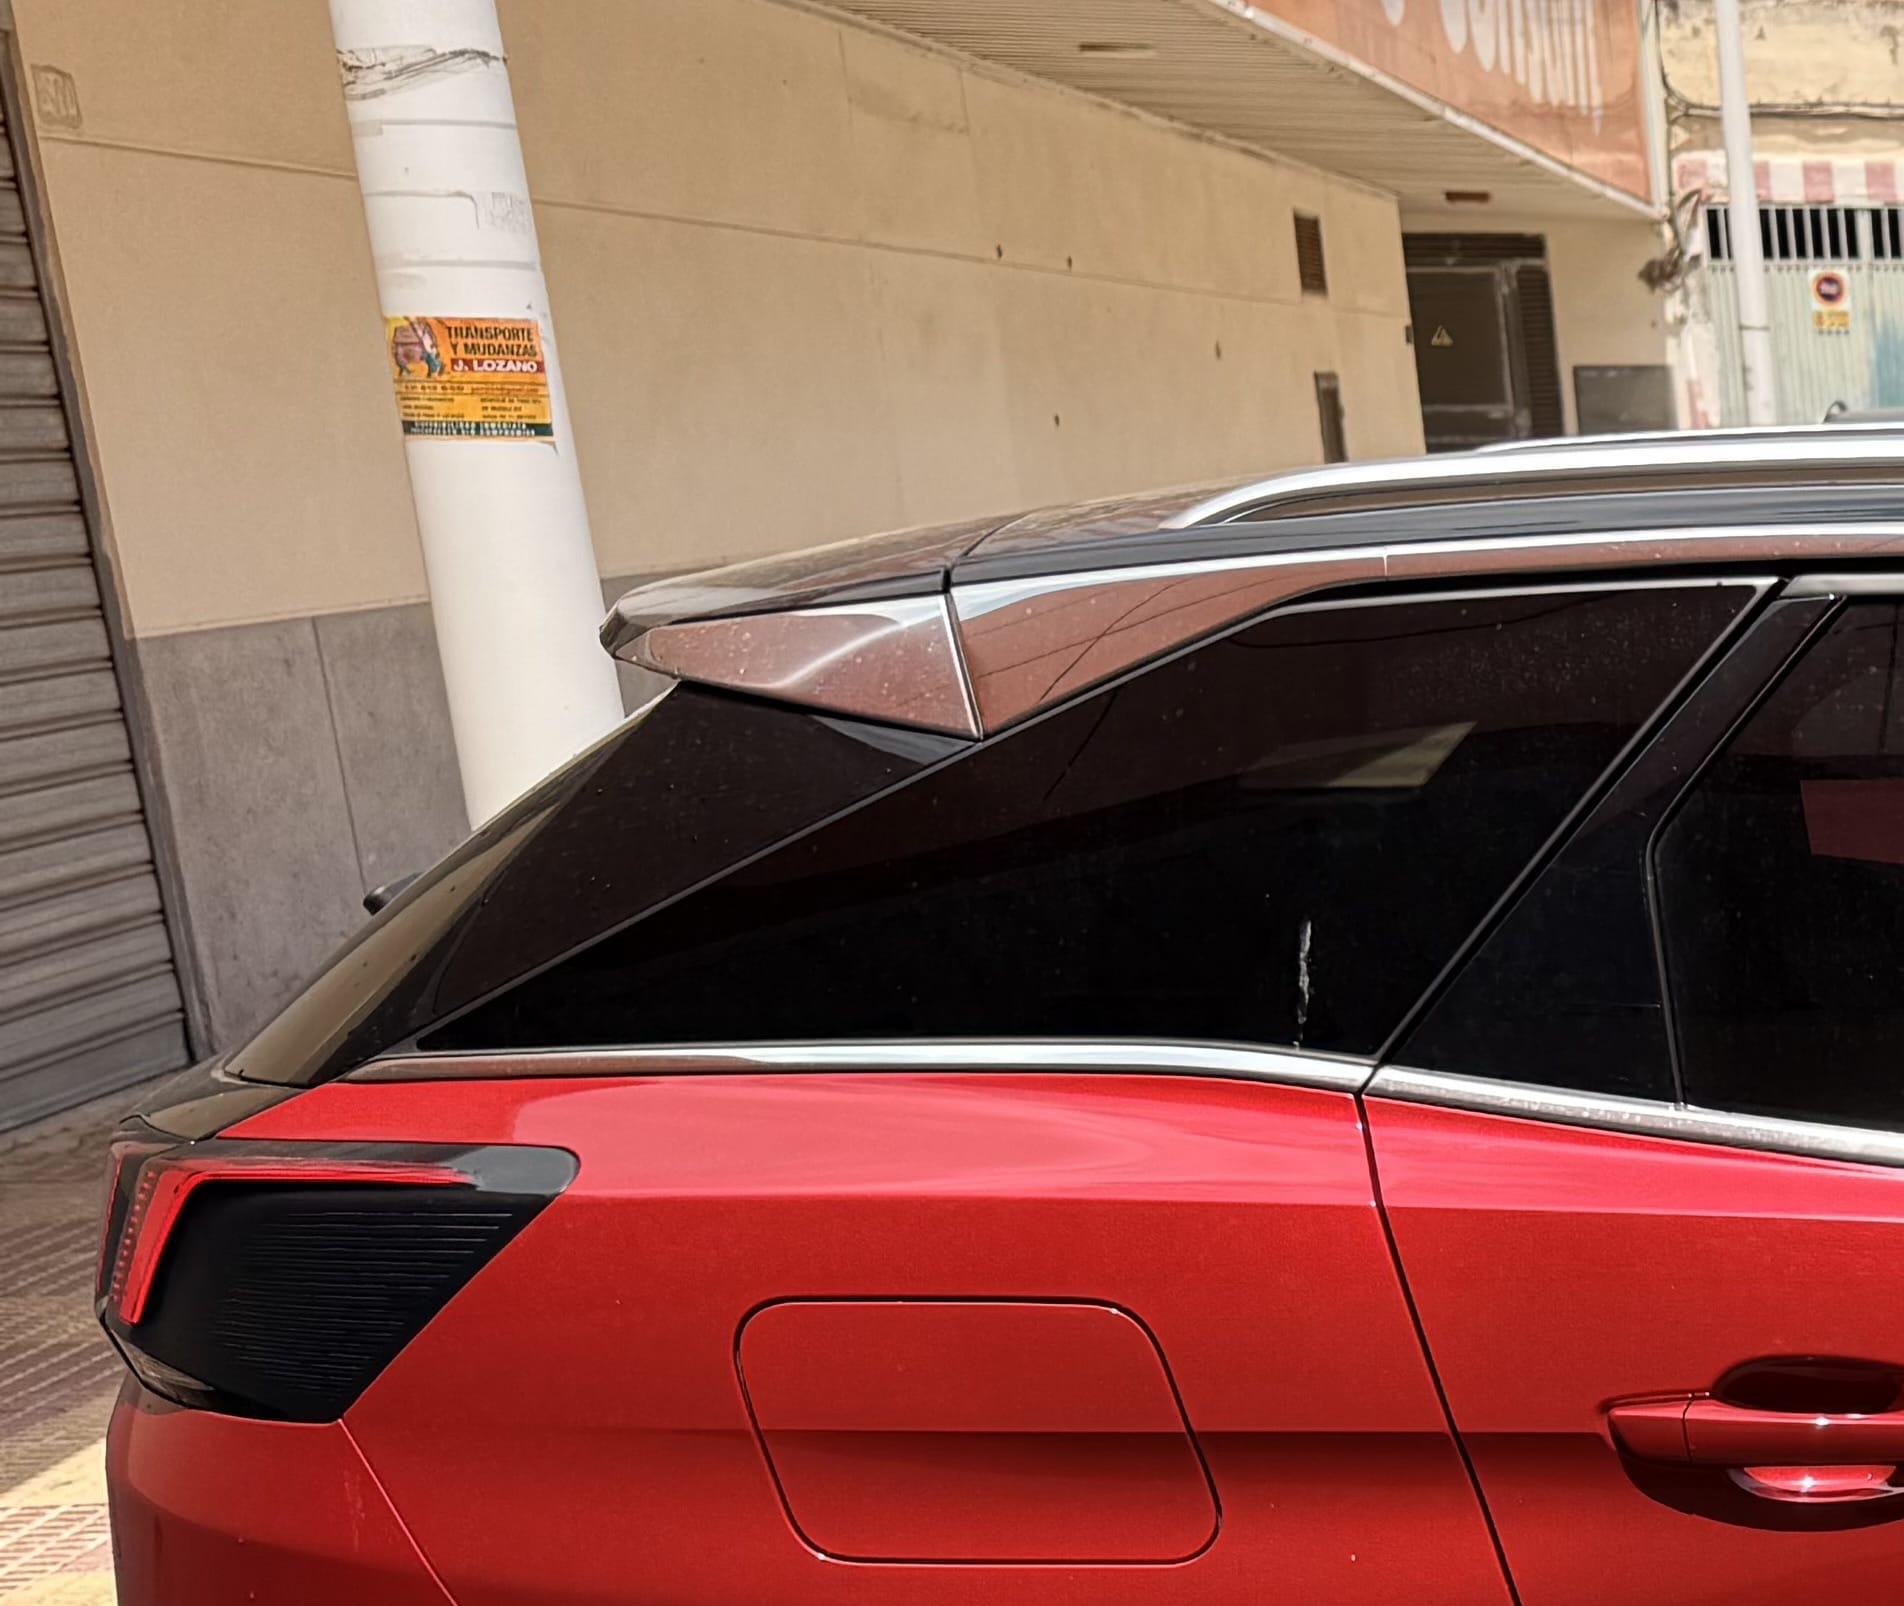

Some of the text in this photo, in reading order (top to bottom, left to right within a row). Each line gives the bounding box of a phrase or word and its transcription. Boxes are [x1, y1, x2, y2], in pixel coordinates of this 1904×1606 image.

[446, 325, 533, 342] TRANSPORTE
[451, 343, 537, 358] Y MUDANZAS
[473, 360, 538, 373] LOZANO
